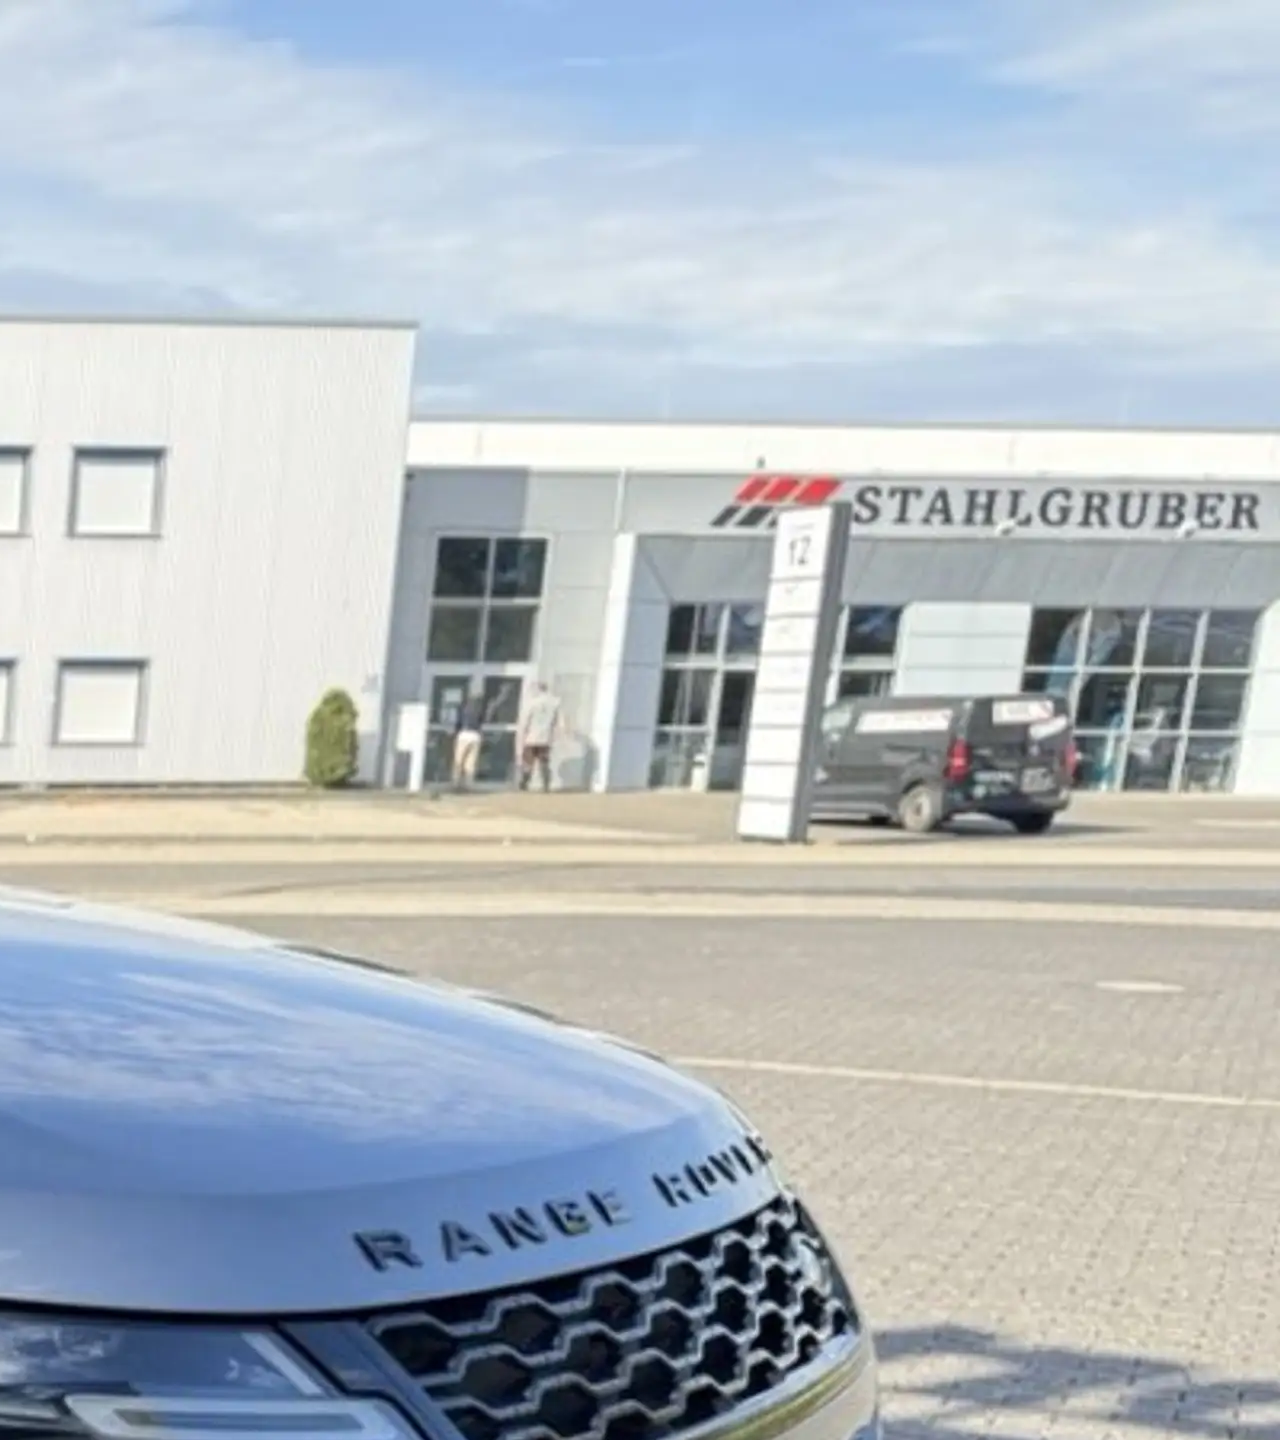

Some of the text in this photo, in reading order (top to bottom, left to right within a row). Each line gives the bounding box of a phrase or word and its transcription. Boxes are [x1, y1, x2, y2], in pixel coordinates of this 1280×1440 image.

[852, 485, 1261, 530] STAHLGRUBER
[789, 535, 812, 566] 12
[352, 1187, 631, 1272] RANGE
